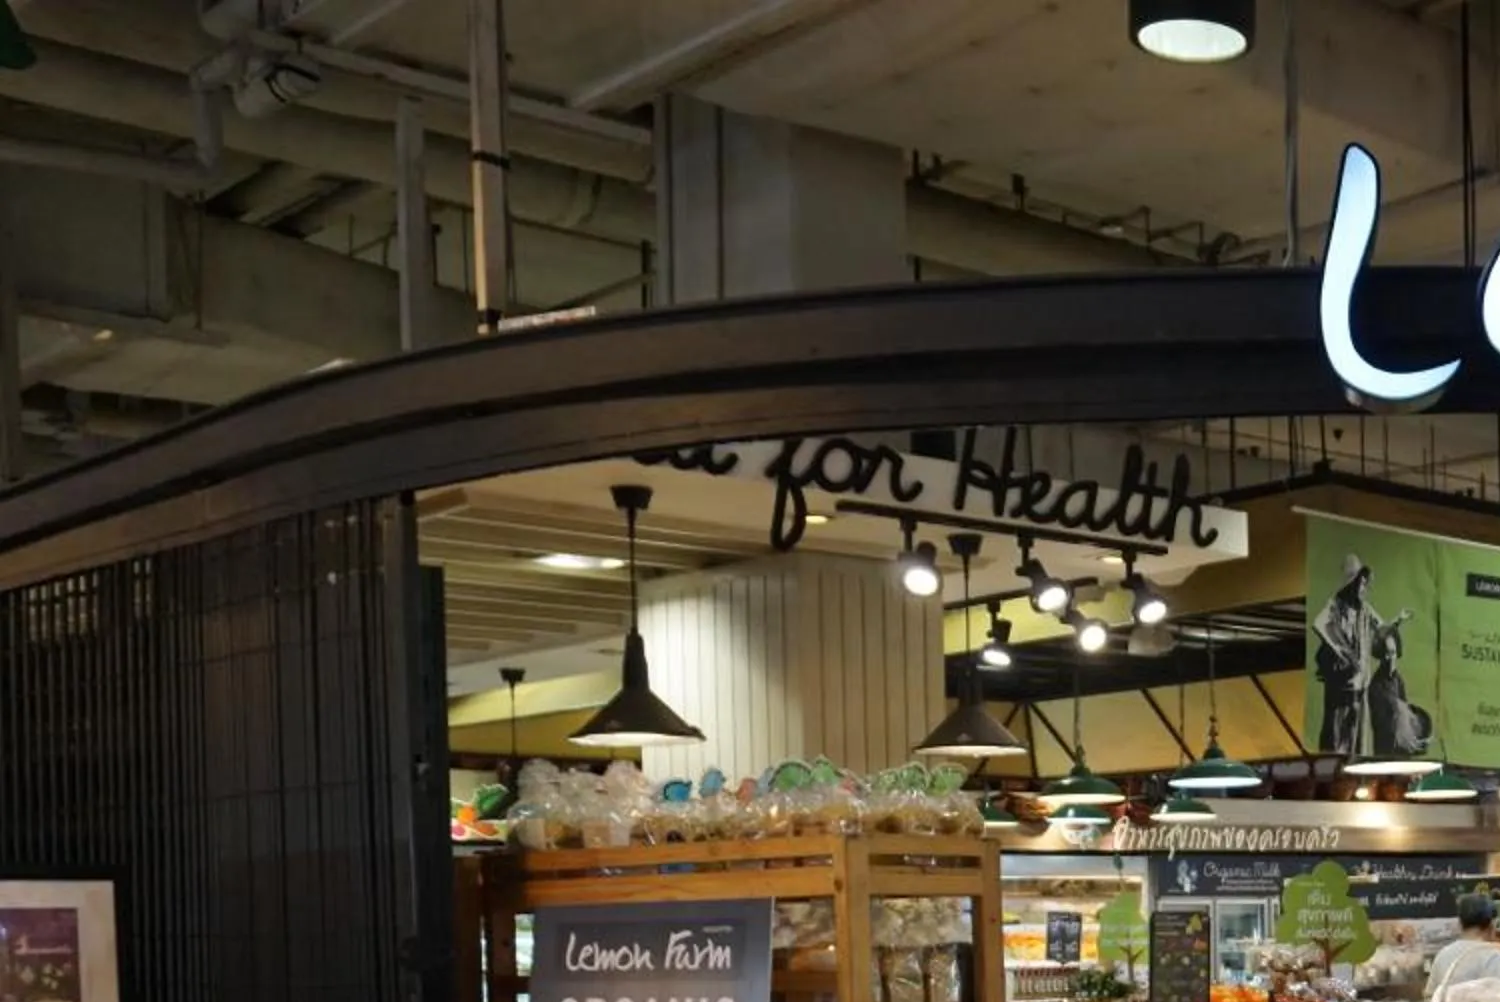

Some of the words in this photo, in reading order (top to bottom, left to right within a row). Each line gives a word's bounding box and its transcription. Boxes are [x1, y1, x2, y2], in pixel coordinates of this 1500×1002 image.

[766, 436, 923, 551] for
[953, 425, 1220, 547] Health
[1203, 861, 1252, 884] Organic
[1253, 861, 1282, 878] Milk
[565, 931, 655, 972] Lemon
[664, 929, 732, 970] Farm
